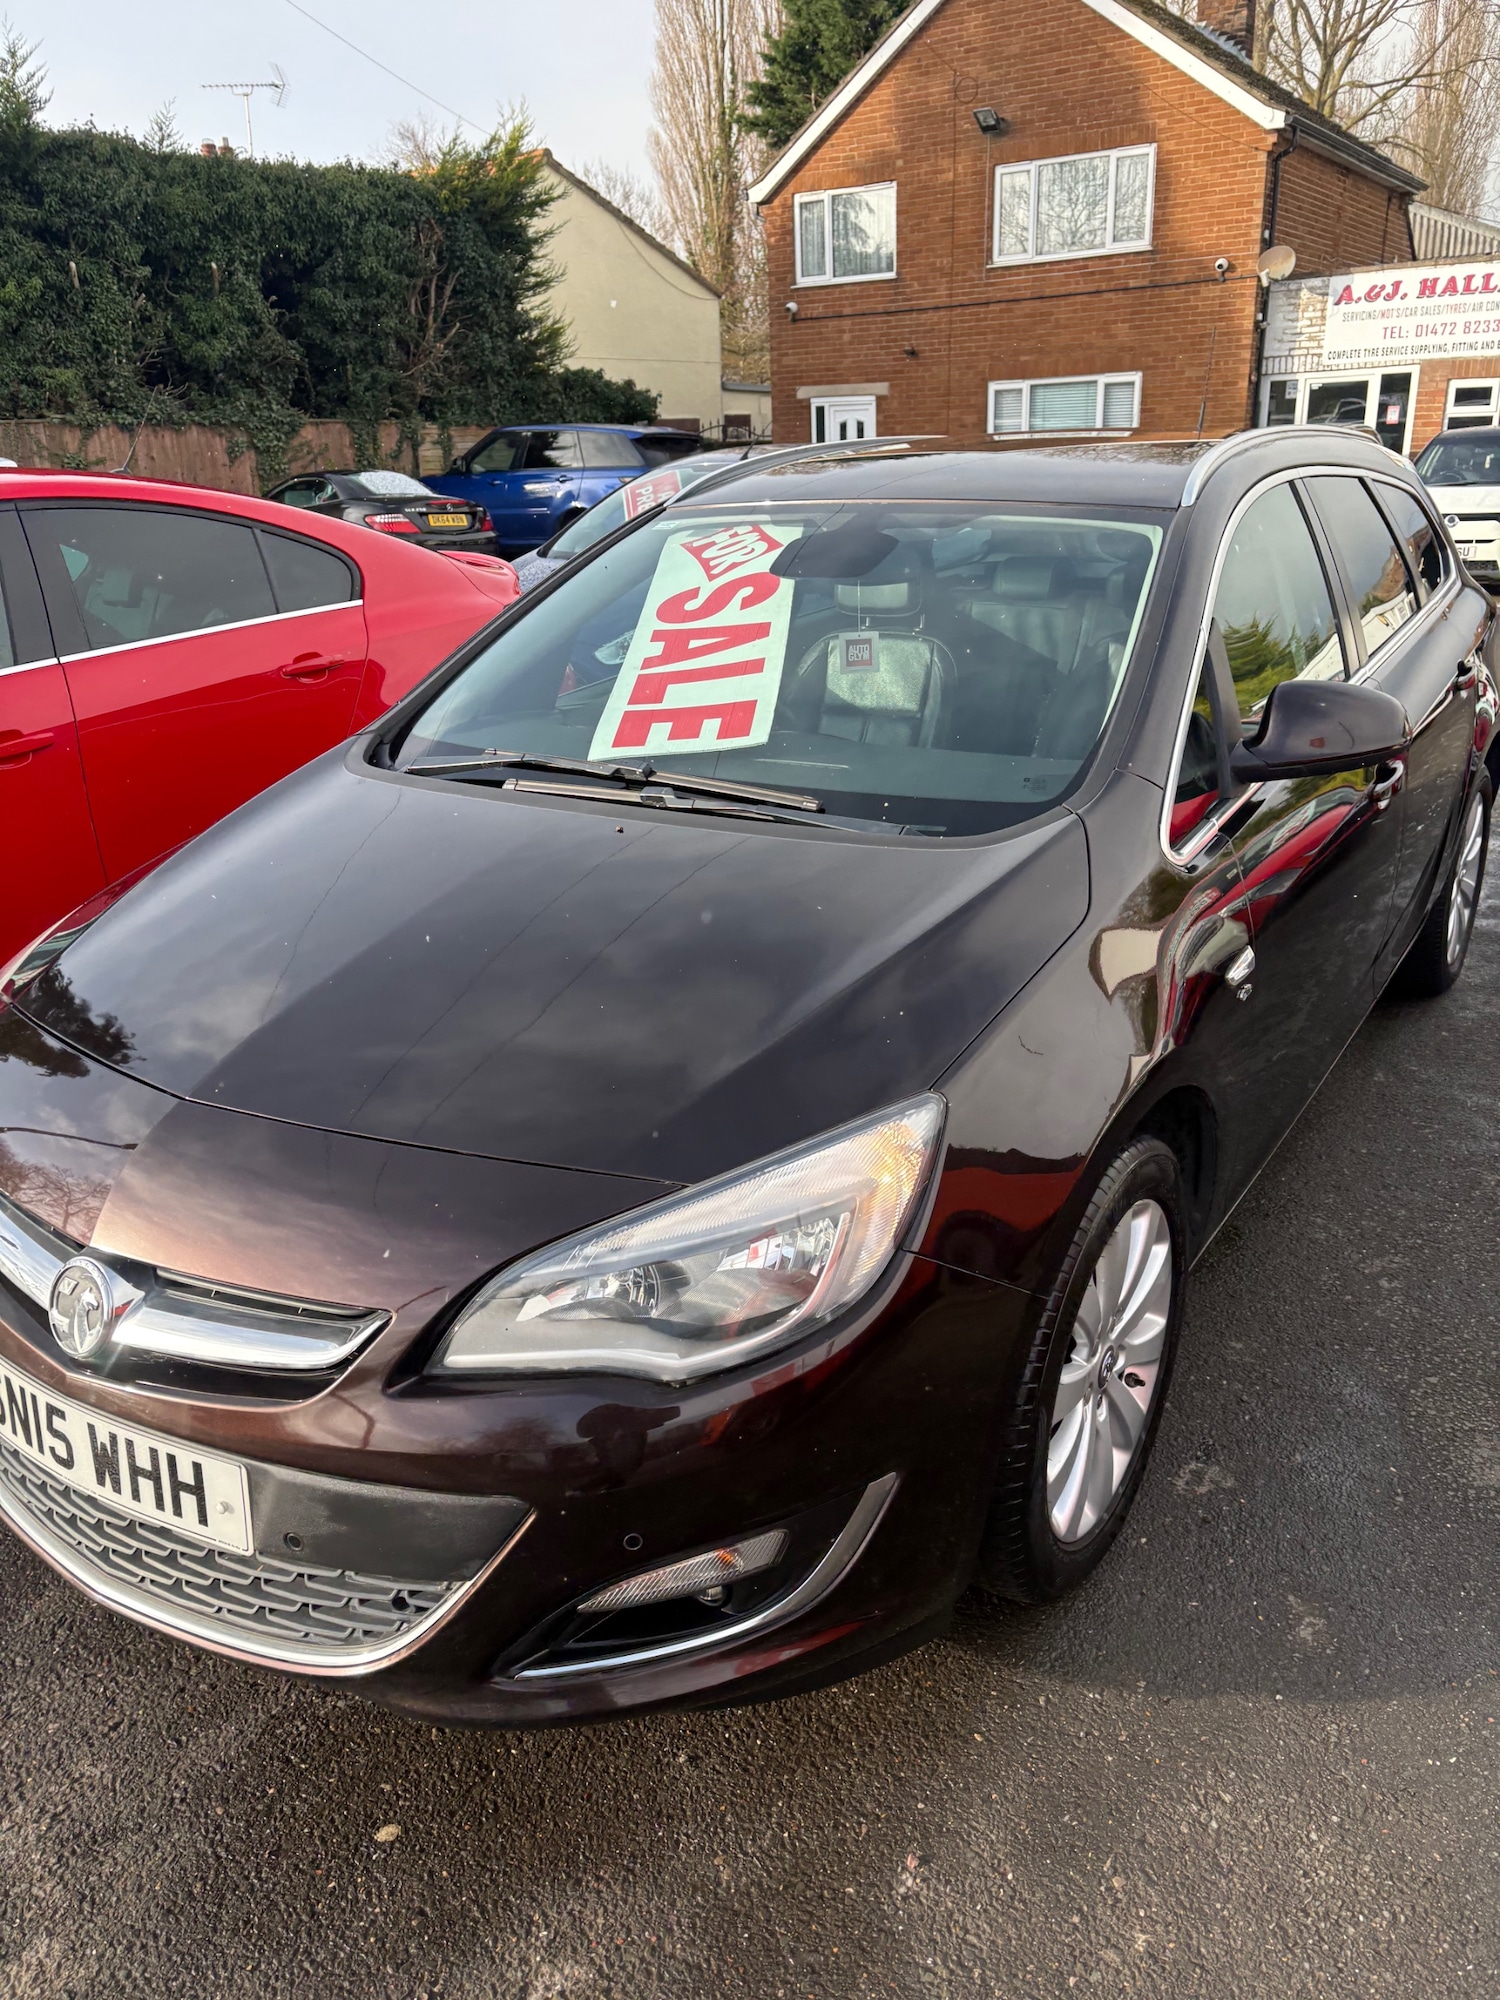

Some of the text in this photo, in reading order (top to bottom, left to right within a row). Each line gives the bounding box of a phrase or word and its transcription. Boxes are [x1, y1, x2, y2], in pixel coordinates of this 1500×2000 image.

[1382, 325, 1409, 340] TEL:
[1415, 322, 1457, 337] 01472
[1327, 349, 1362, 360] COMPLETE
[1364, 347, 1380, 358] TYRE
[1381, 345, 1409, 357] SERVICE
[1410, 342, 1450, 354] SUPPLYING,
[1451, 341, 1479, 352] FITTING
[1480, 340, 1495, 350] AND
[611, 525, 780, 748] FOR SALE
[848, 644, 870, 655] AUTO
[0, 1374, 209, 1528] N15 WHH
